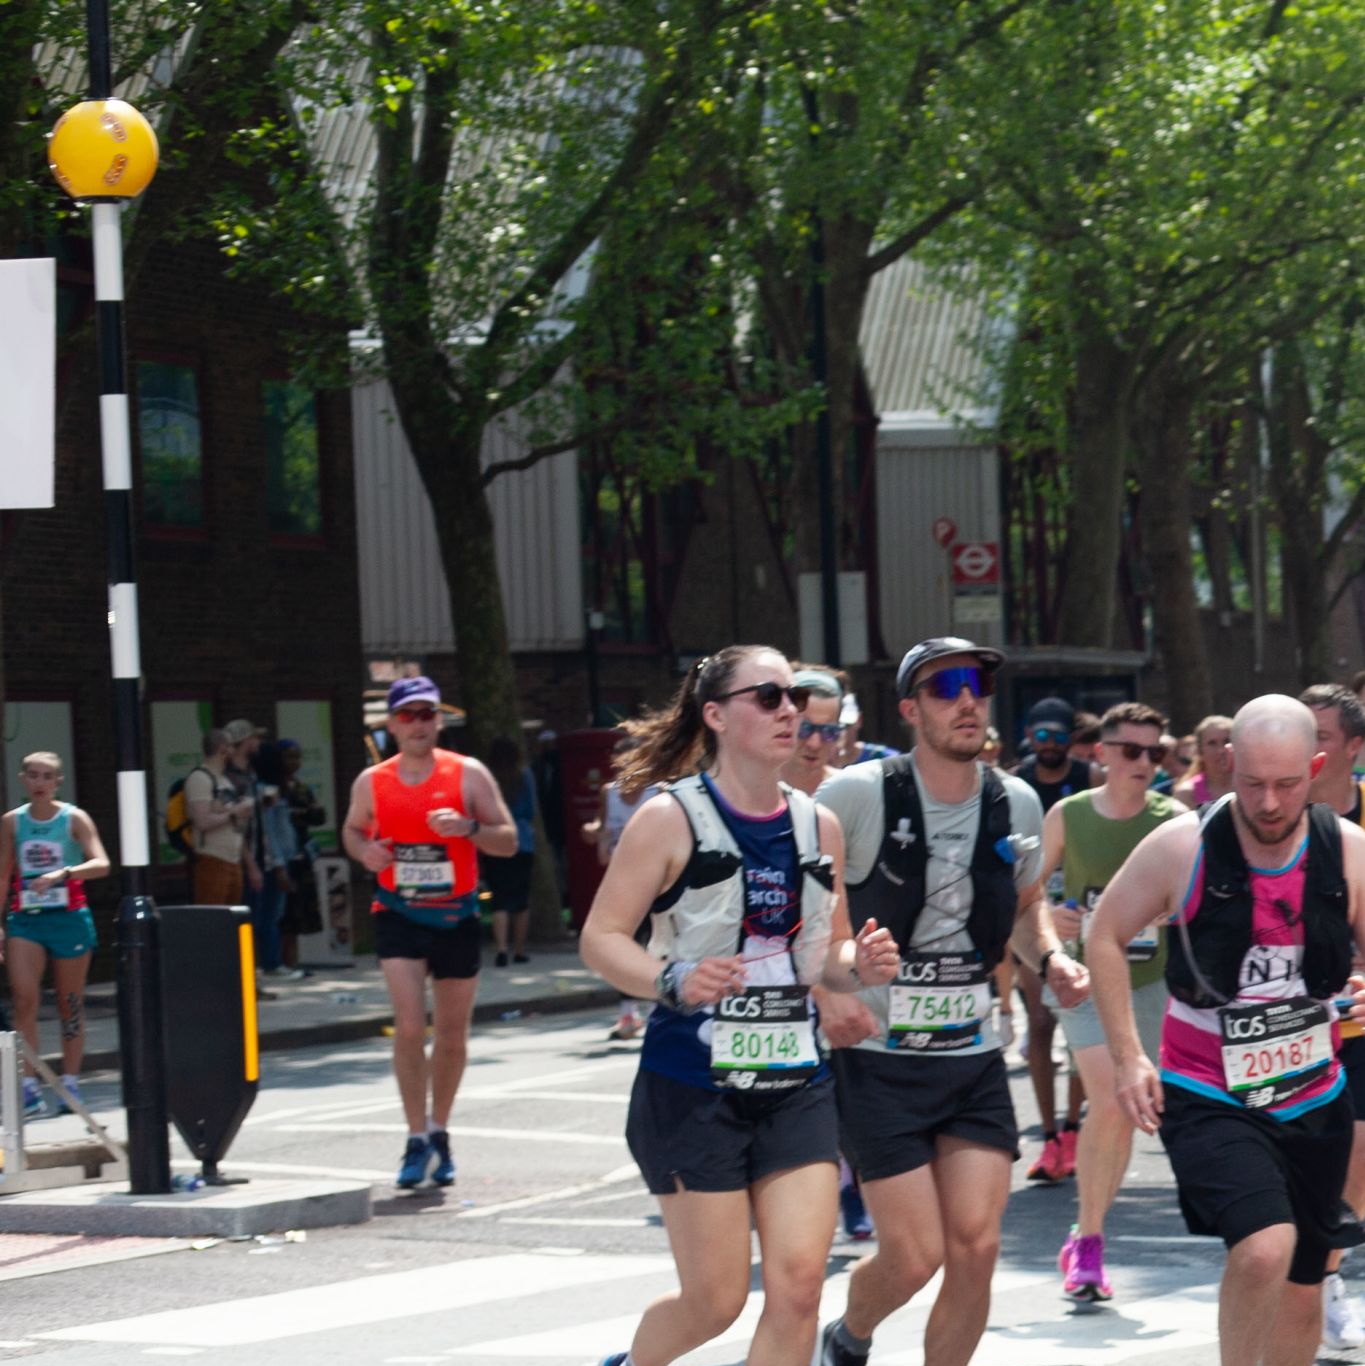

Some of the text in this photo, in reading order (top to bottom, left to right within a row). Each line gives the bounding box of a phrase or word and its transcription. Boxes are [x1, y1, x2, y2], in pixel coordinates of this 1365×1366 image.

[898, 958, 938, 982] tcs
[721, 995, 761, 1018] tcs
[908, 993, 976, 1020] 75412
[1224, 1014, 1267, 1039] tcs
[1242, 1035, 1315, 1079] 20187
